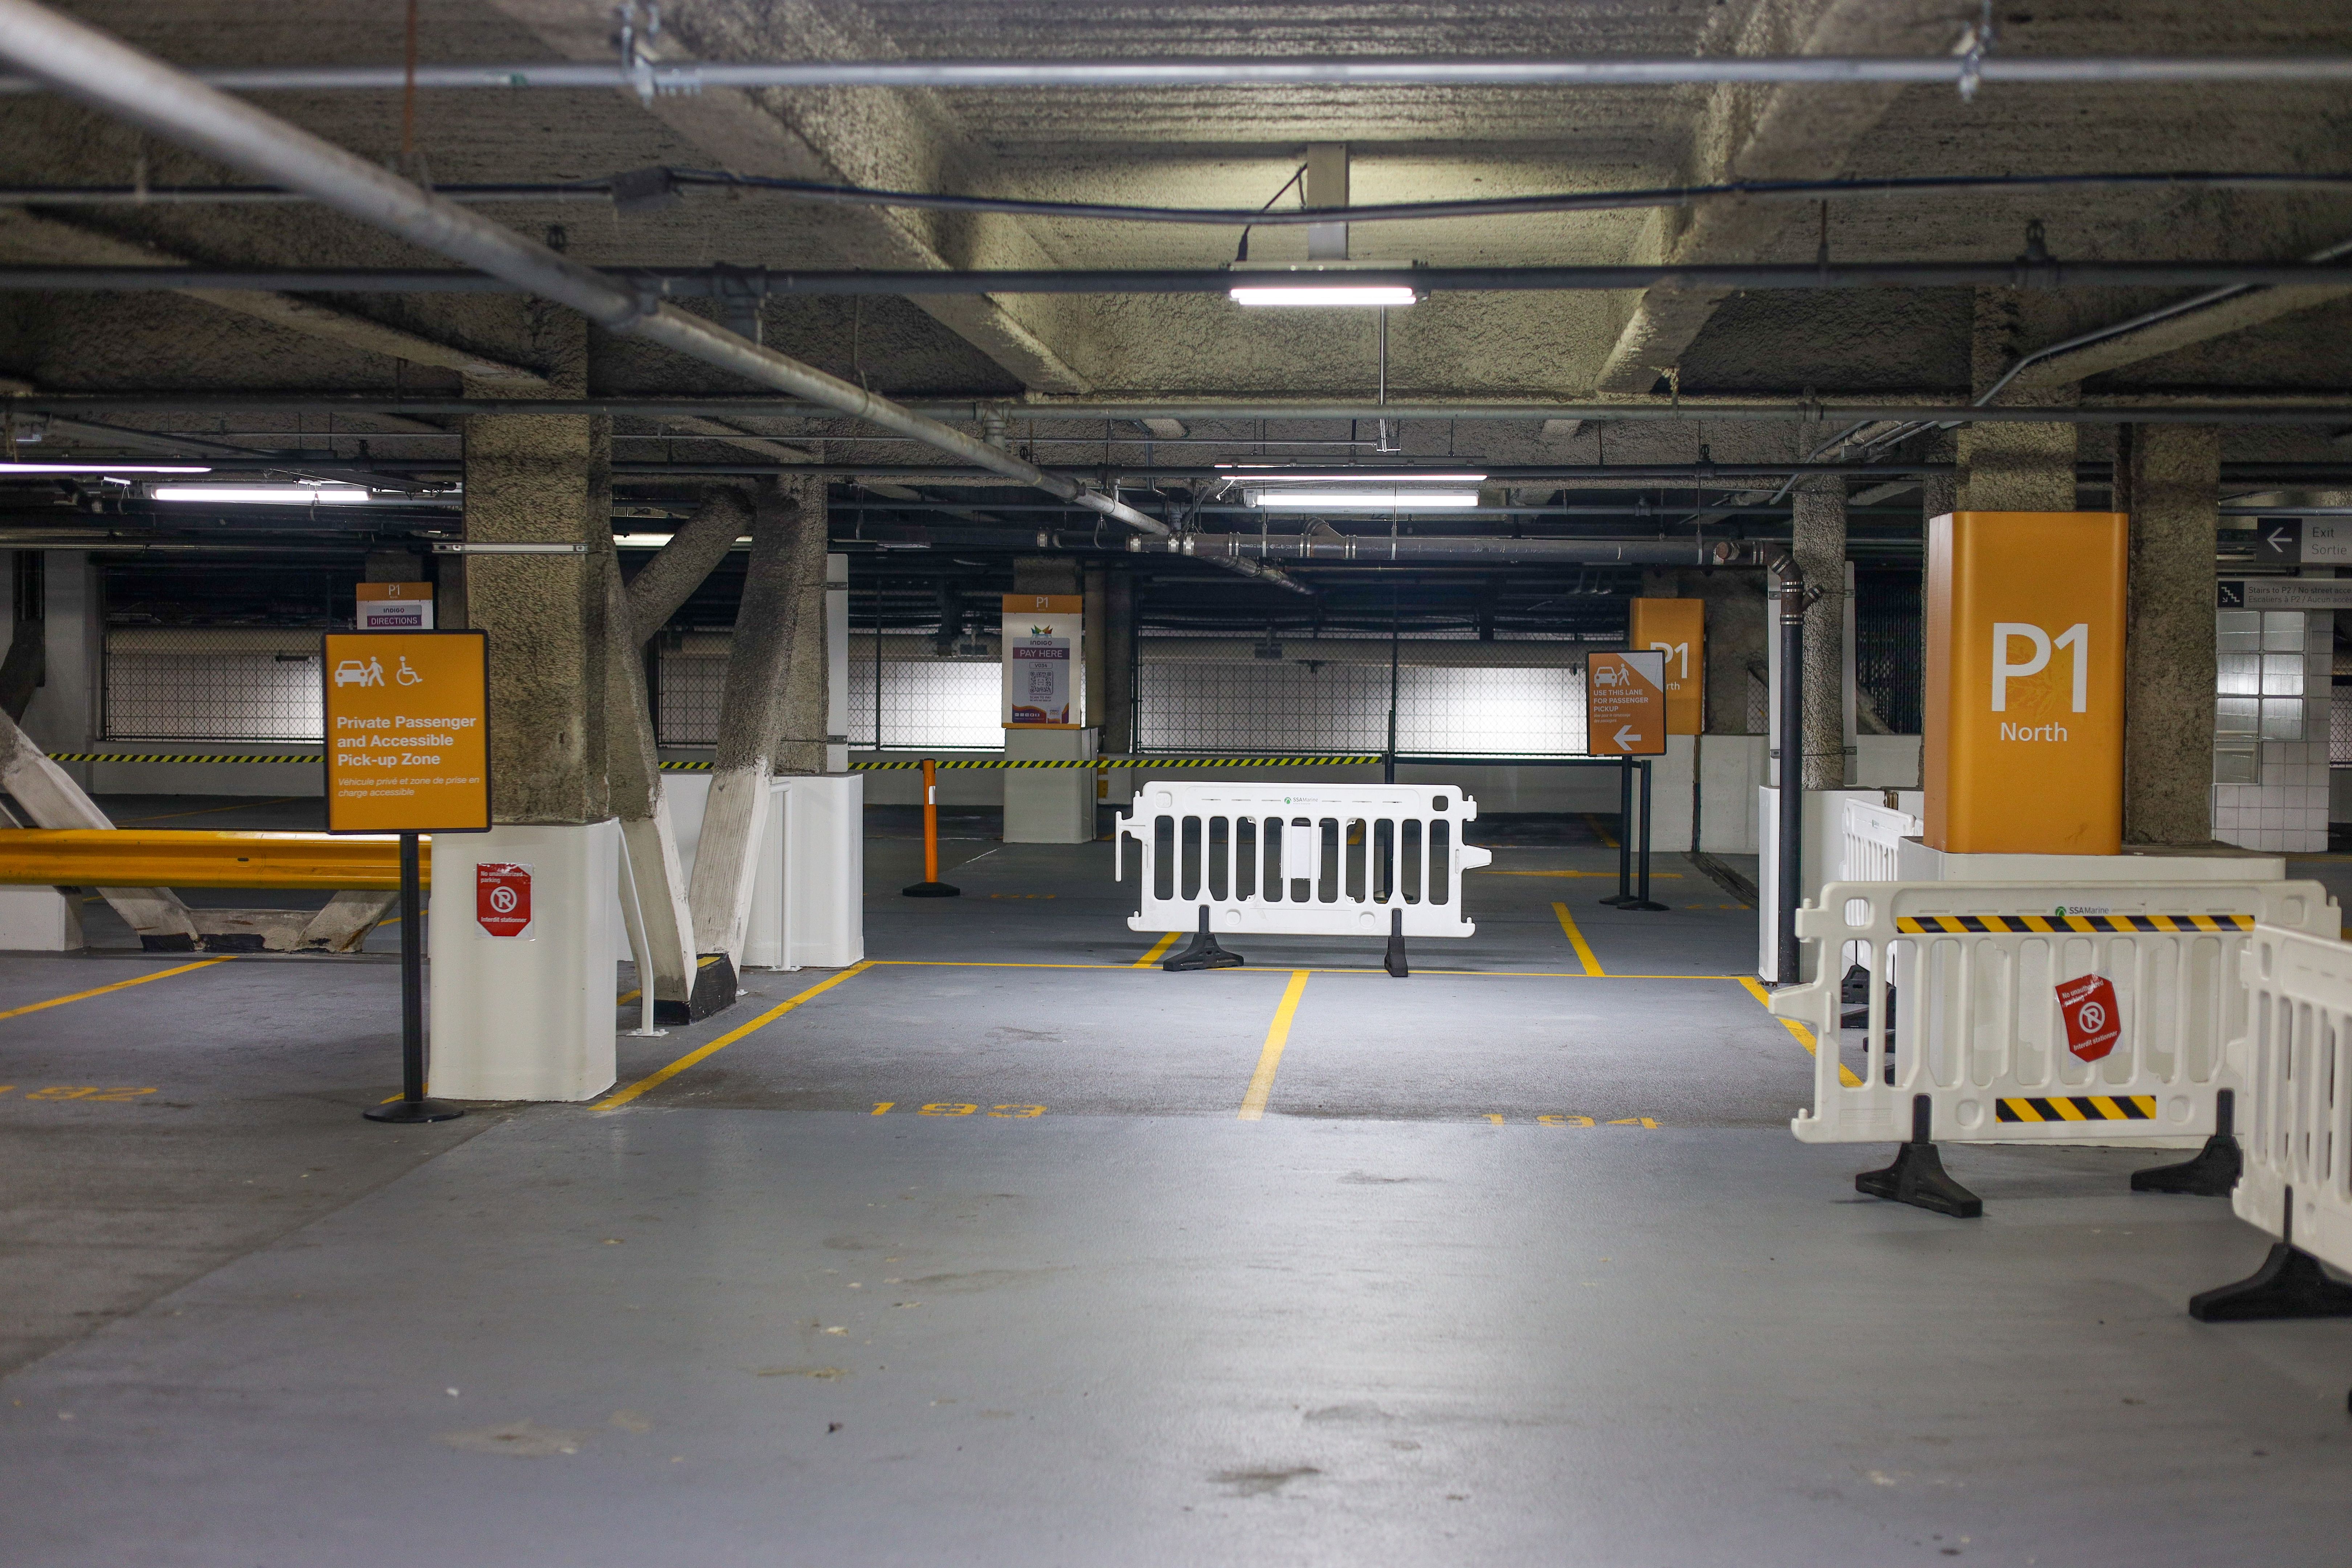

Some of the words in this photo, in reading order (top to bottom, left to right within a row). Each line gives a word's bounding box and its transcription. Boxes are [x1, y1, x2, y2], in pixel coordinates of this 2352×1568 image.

[2312, 527, 2335, 538] Exit
[2312, 544, 2347, 555] Sortie
[389, 584, 400, 595] P1
[1037, 597, 1048, 608] P1
[1992, 622, 2088, 713] P1
[337, 717, 391, 728] Private
[395, 716, 477, 730] Passenger
[2001, 722, 2068, 742] North
[337, 735, 366, 747] and
[370, 734, 454, 747] Accessible
[337, 754, 397, 768] Pick-up
[401, 753, 441, 765] Zone
[338, 777, 375, 786] Véhicule
[376, 777, 397, 787] privé
[445, 776, 467, 786] prise
[338, 789, 367, 798] charge
[369, 788, 415, 796] accessible
[2073, 1041, 2092, 1051] Interdit
[2092, 1030, 2118, 1044] stationner
[871, 1102, 1048, 1118] 193
[1481, 1113, 1665, 1129] 194
